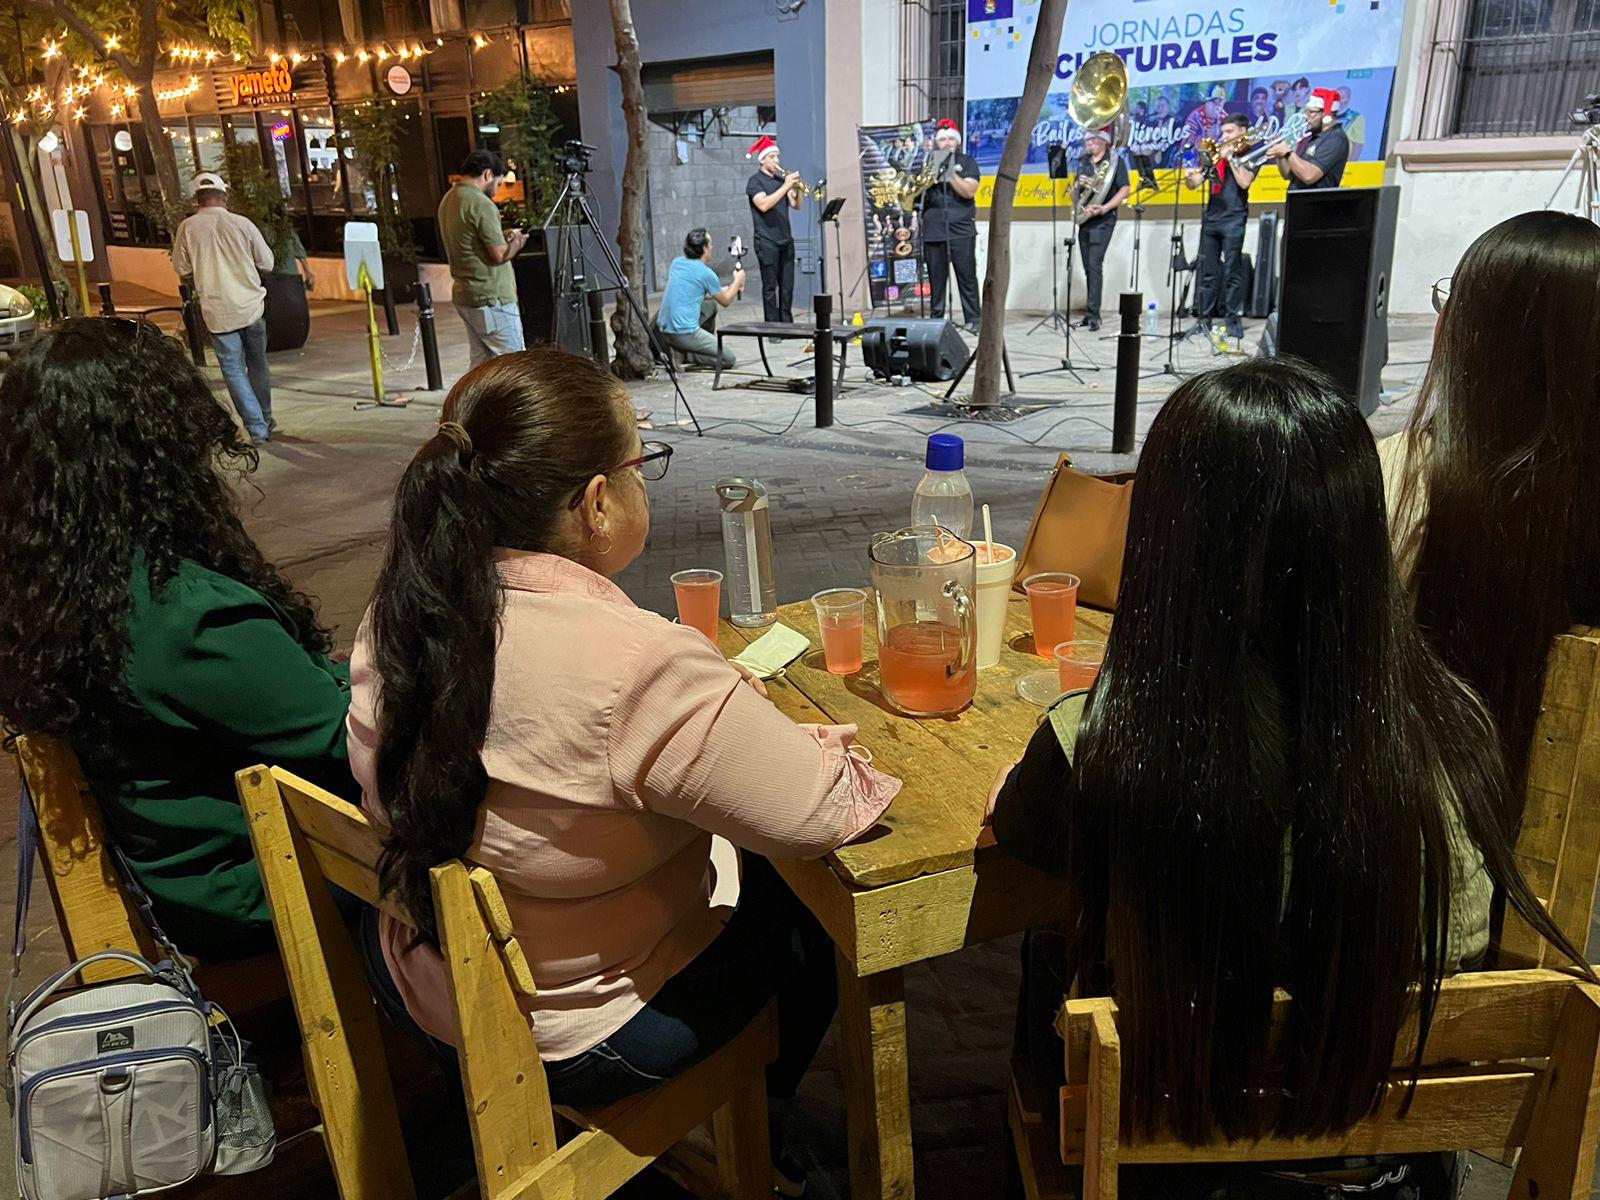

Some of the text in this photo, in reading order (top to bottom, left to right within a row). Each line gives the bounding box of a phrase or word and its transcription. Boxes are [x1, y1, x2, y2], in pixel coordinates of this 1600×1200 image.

[1084, 8, 1245, 48] JORNADAS
[1055, 33, 1278, 79] CTURALES
[1031, 119, 1084, 148] Bailes
